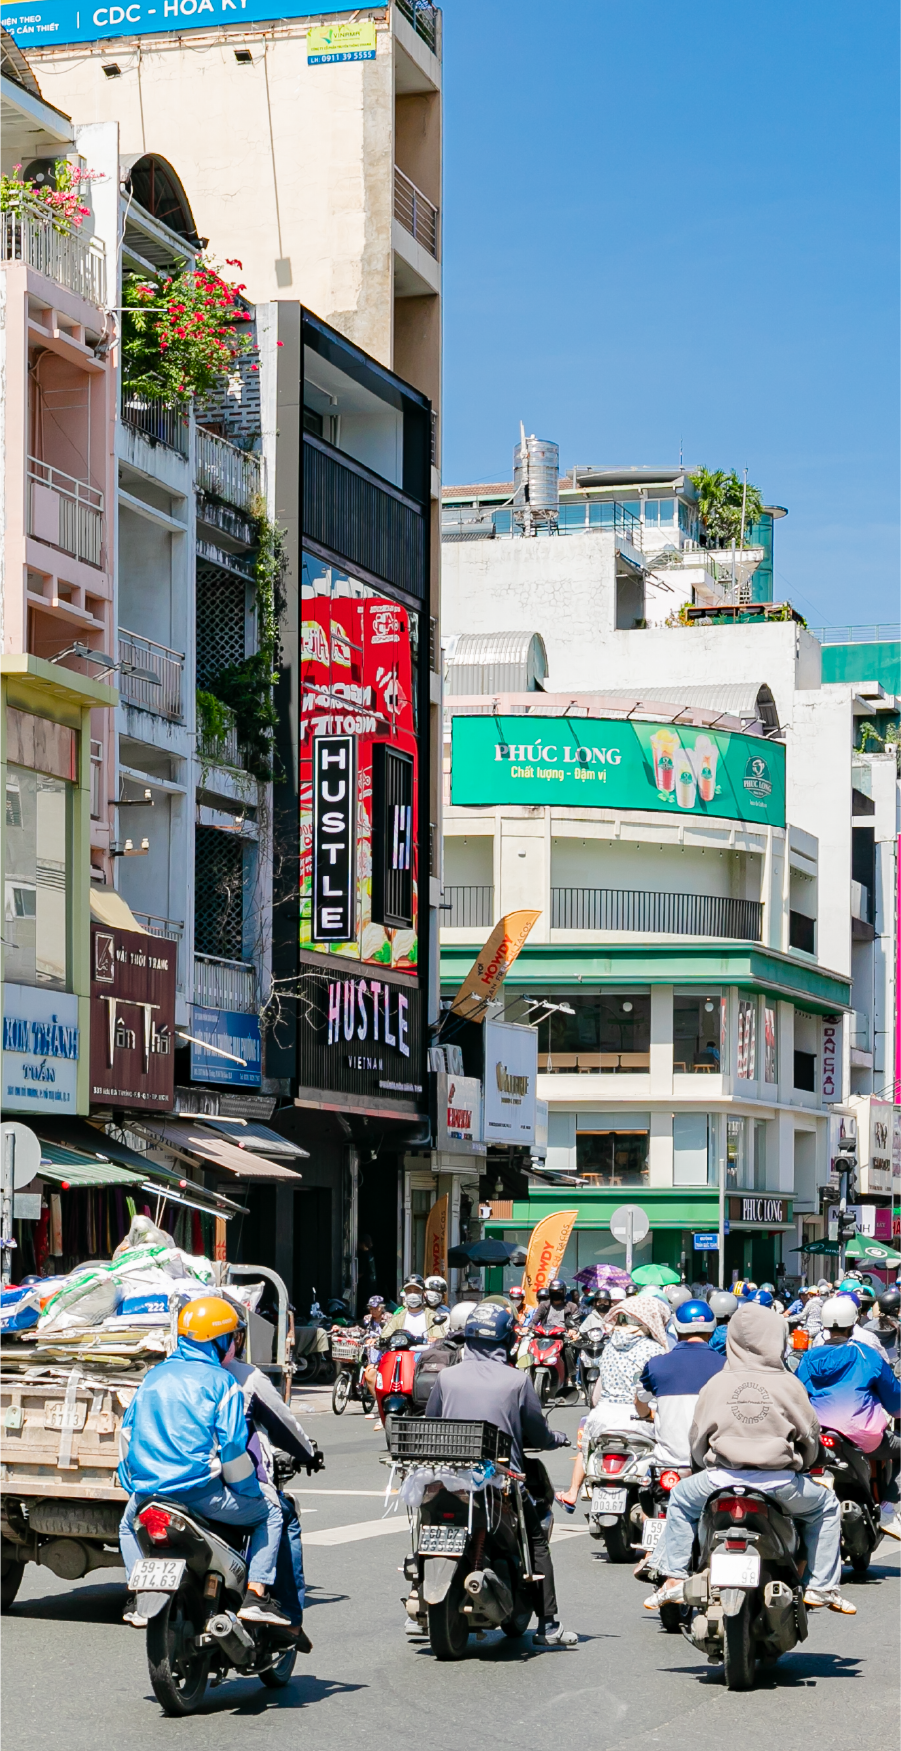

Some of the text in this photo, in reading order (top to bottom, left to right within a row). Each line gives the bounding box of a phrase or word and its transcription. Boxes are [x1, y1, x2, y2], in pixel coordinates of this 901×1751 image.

[19, 15, 41, 23] THEO
[93, 5, 141, 26] CDC
[36, 23, 59, 32] THIẾT
[322, 54, 340, 62] 0911
[494, 739, 622, 765] PHÚC LONG
[511, 765, 534, 778] Chất
[537, 767, 564, 782] lượng
[573, 767, 596, 783] Đậm
[598, 769, 606, 783] vị
[321, 748, 346, 929] HUSTLE
[513, 921, 531, 948] TACOS
[148, 957, 168, 971] TRANG
[481, 934, 512, 984] HOWDY
[328, 979, 410, 1058] HUSTLE
[3, 1016, 30, 1053] KIM
[100, 995, 136, 1069] Tân
[136, 1002, 171, 1074] Thái
[348, 1055, 383, 1071] VIETNAM
[763, 1200, 783, 1222] LONG
[532, 1240, 554, 1293] HOWDY
[593, 1500, 624, 1511] 003.67
[141, 1562, 177, 1574] 59-Y2
[132, 1575, 177, 1587] 814.63
